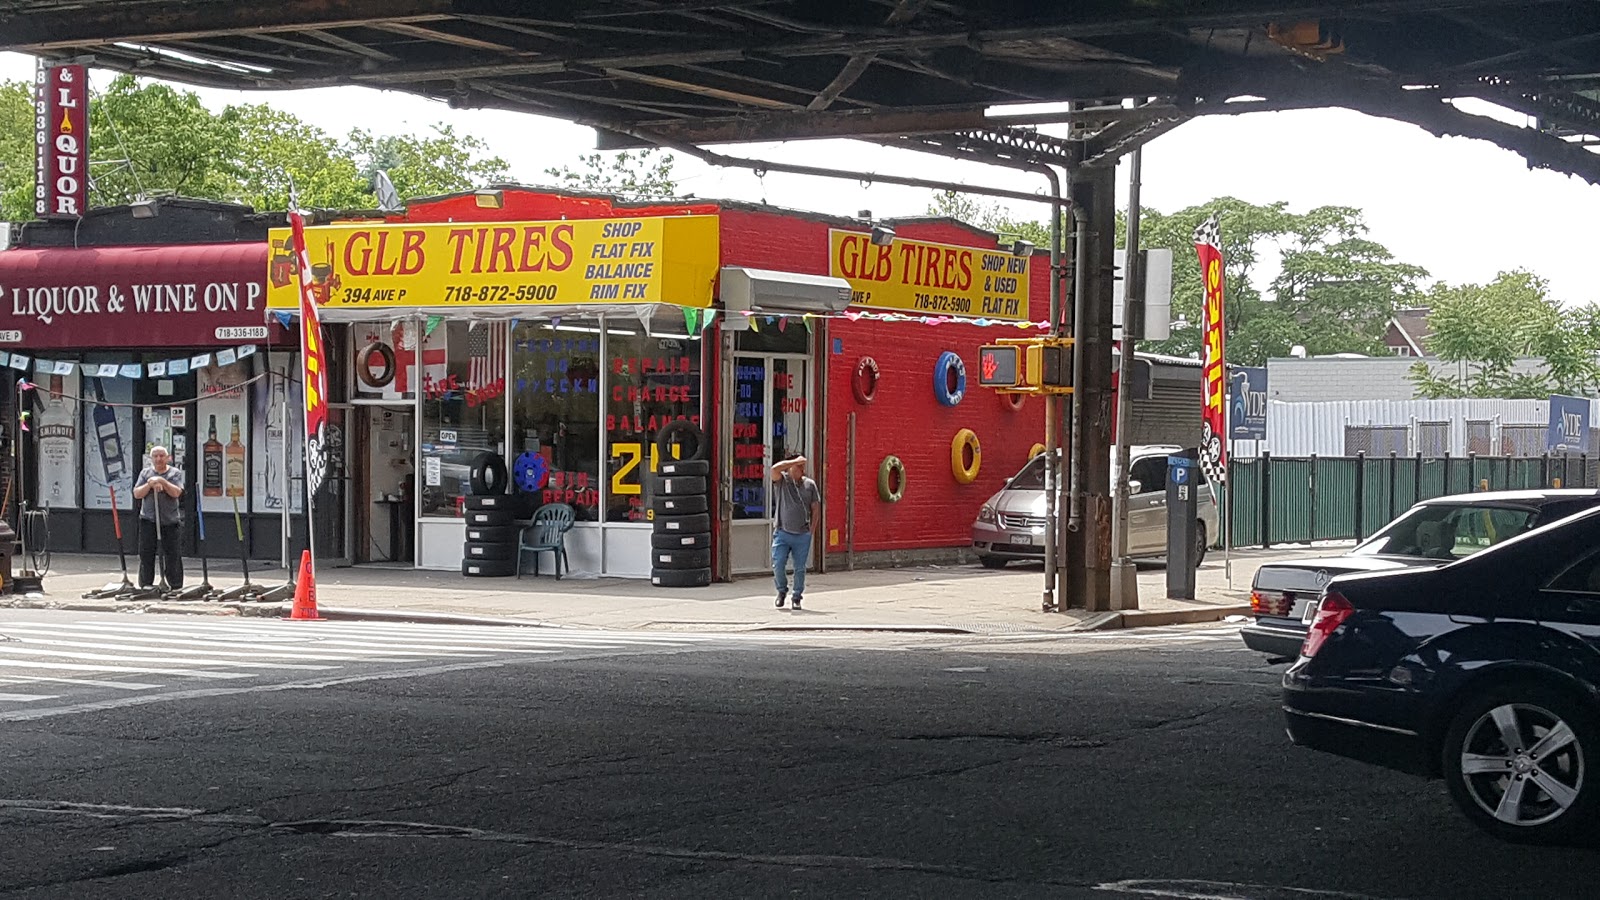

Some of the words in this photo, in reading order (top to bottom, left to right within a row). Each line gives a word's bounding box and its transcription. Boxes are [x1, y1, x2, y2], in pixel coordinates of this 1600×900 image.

[59, 68, 73, 82] &
[602, 222, 642, 238] SHOP
[344, 230, 427, 276] GLB
[448, 225, 574, 274] TIRES
[591, 243, 624, 259] FLAT
[630, 242, 655, 257] FIX
[585, 263, 654, 279] BALANCE
[839, 236, 893, 282] GLB
[899, 243, 972, 291] TIRES
[981, 254, 1004, 272] SHOP
[1006, 258, 1027, 275] NEW
[444, 284, 557, 302] 718-872-5900
[590, 284, 619, 299] RIM
[623, 283, 649, 299] FIX
[984, 276, 991, 292] &
[994, 276, 1018, 294] USED
[11, 284, 100, 324] LIQUOR
[107, 284, 125, 313] &
[131, 284, 197, 312] WINE
[204, 282, 239, 311] ON
[246, 282, 260, 311] P
[342, 288, 371, 303] 394
[373, 289, 394, 302] AVE
[398, 289, 407, 301] P
[866, 291, 872, 304] P
[914, 292, 971, 313] 718-872-5900
[982, 296, 1002, 313] FLAT
[1004, 299, 1020, 315] FIX
[15, 331, 20, 340] P
[218, 327, 264, 338] 718-336-1188
[613, 357, 691, 374] REPAIR
[612, 385, 691, 402] CHANGE
[441, 432, 456, 441] OPEN
[1176, 468, 1186, 481] P
[543, 489, 599, 505] REPAIR
